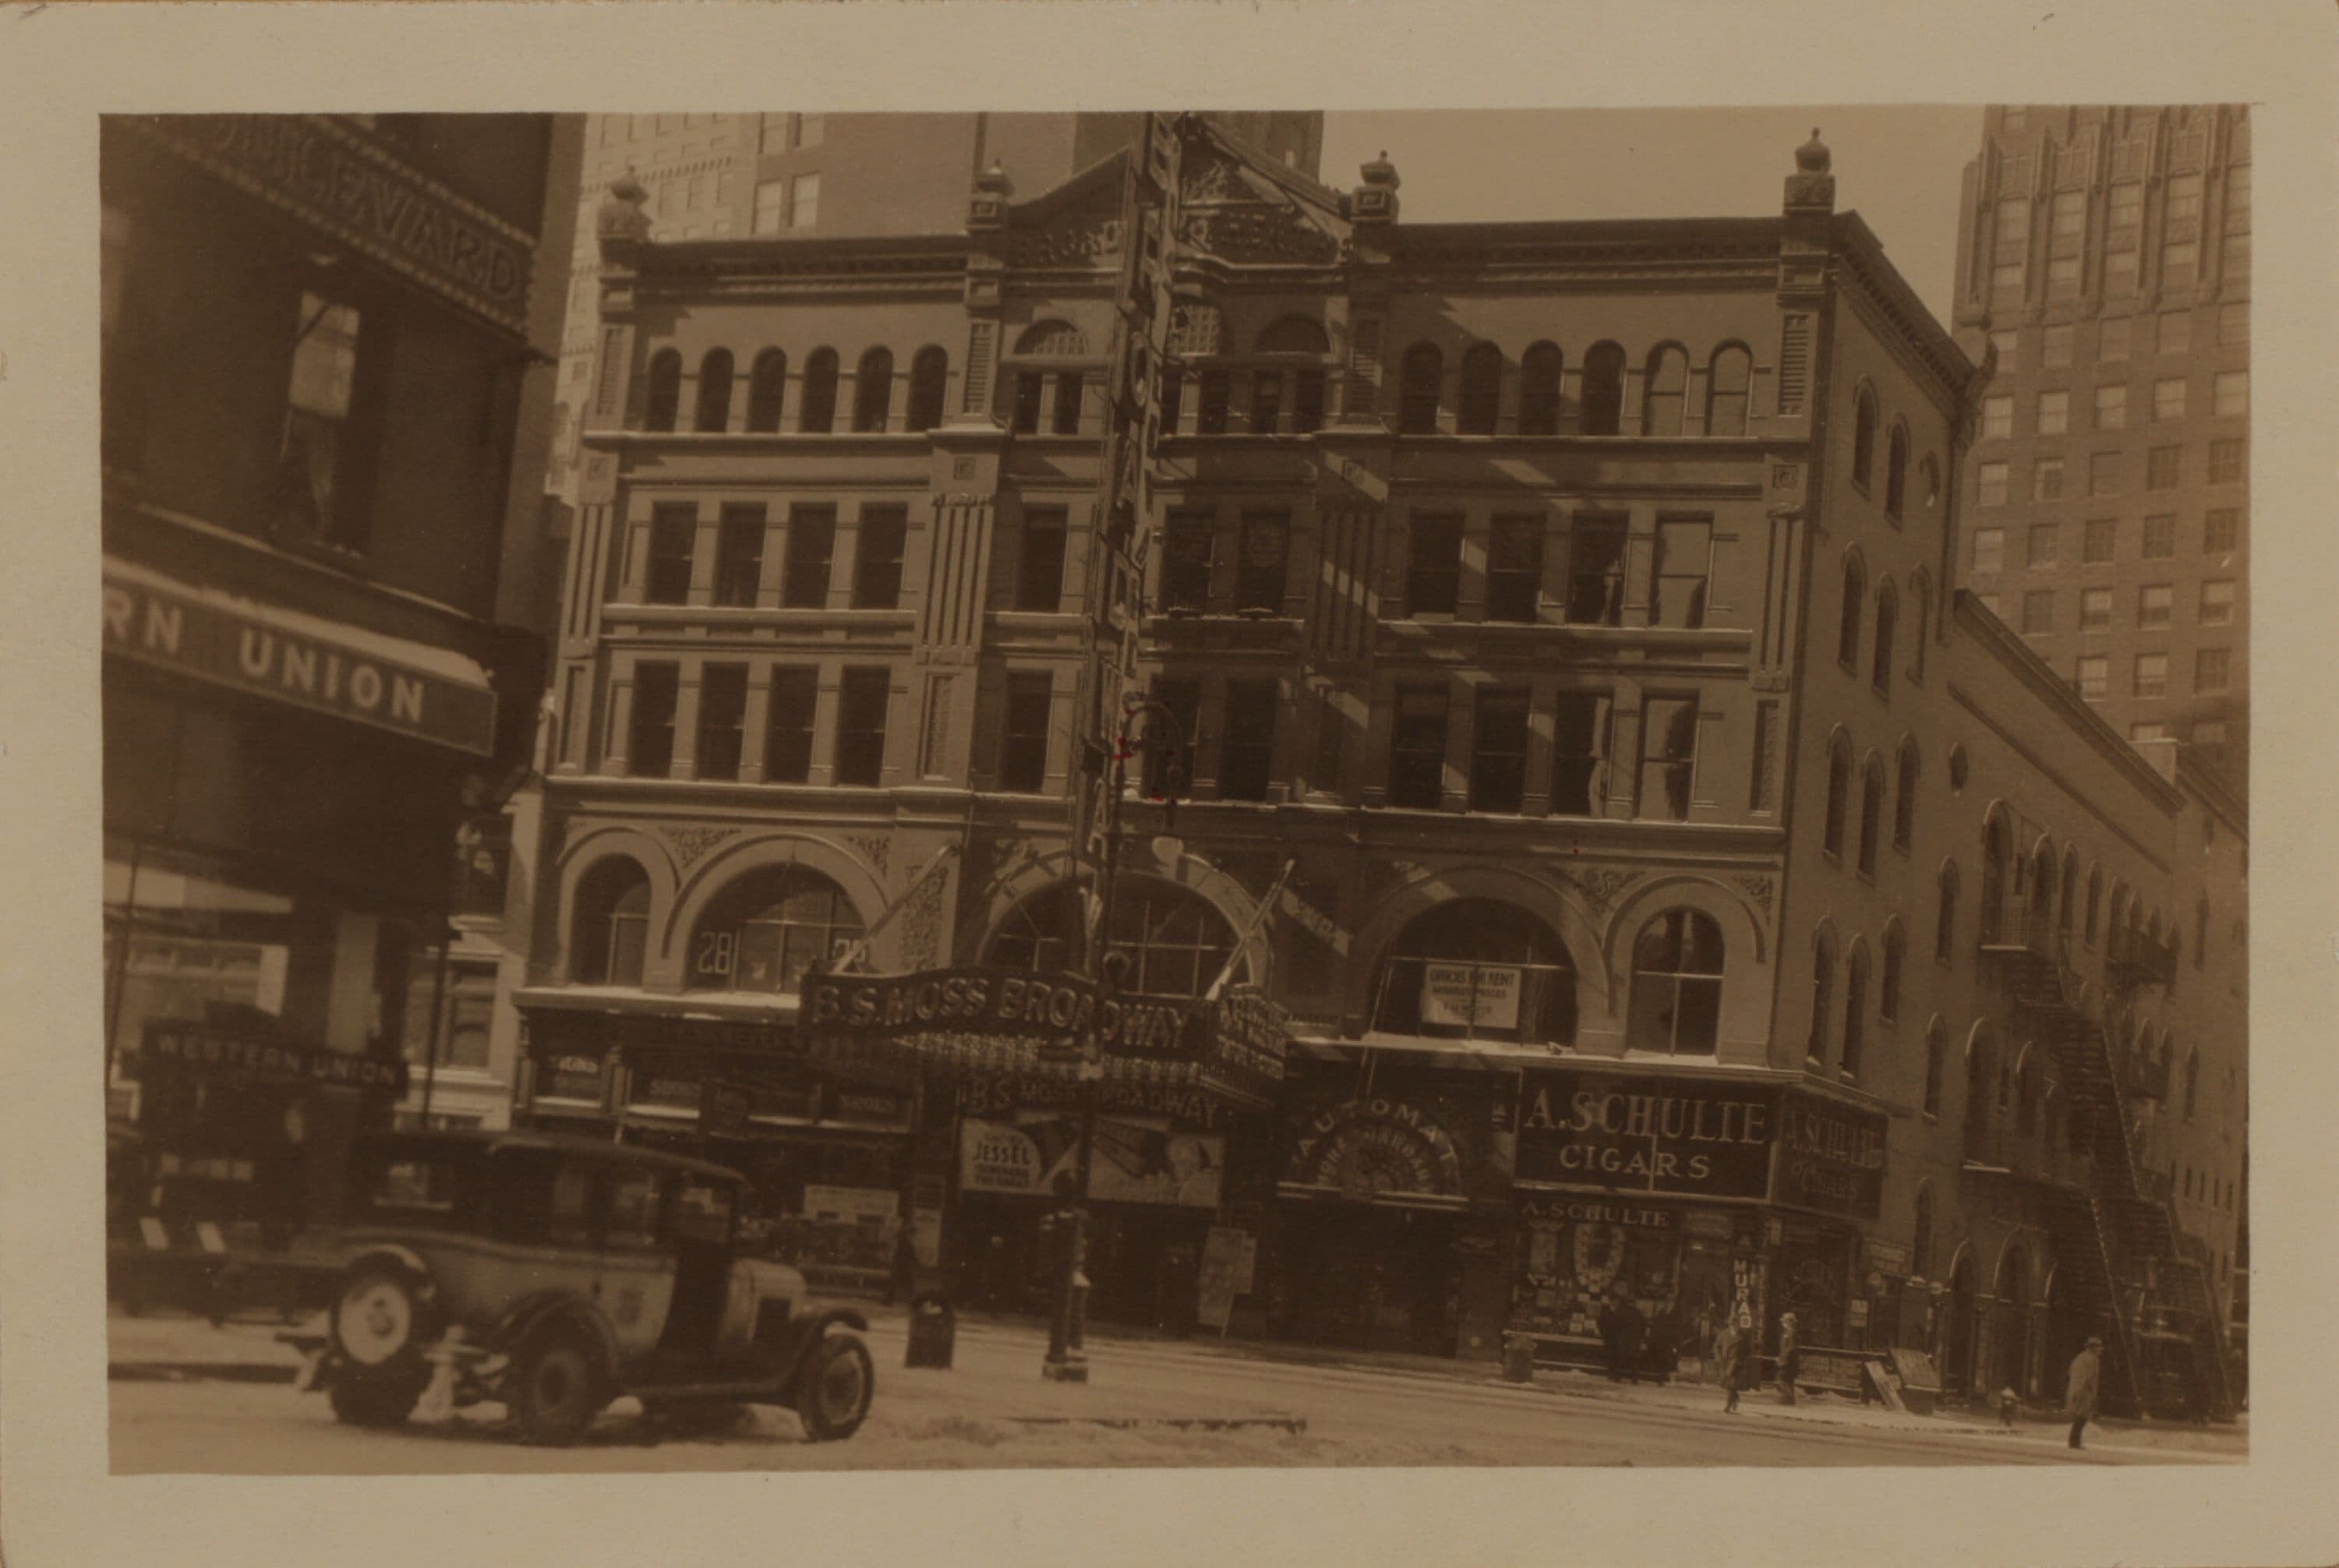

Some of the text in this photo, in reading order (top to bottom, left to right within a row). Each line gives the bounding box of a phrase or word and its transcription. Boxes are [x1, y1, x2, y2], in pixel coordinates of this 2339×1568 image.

[239, 627, 426, 723] UNION
[698, 931, 731, 974] 28
[998, 977, 1188, 1048] BROADWAY
[311, 1054, 399, 1086] UNION
[972, 1140, 1031, 1165] JESSEL
[1297, 1097, 1459, 1163] AUTOMAT
[1560, 1144, 1712, 1179] CIGARS
[1733, 1258, 1753, 1330] MURAD
